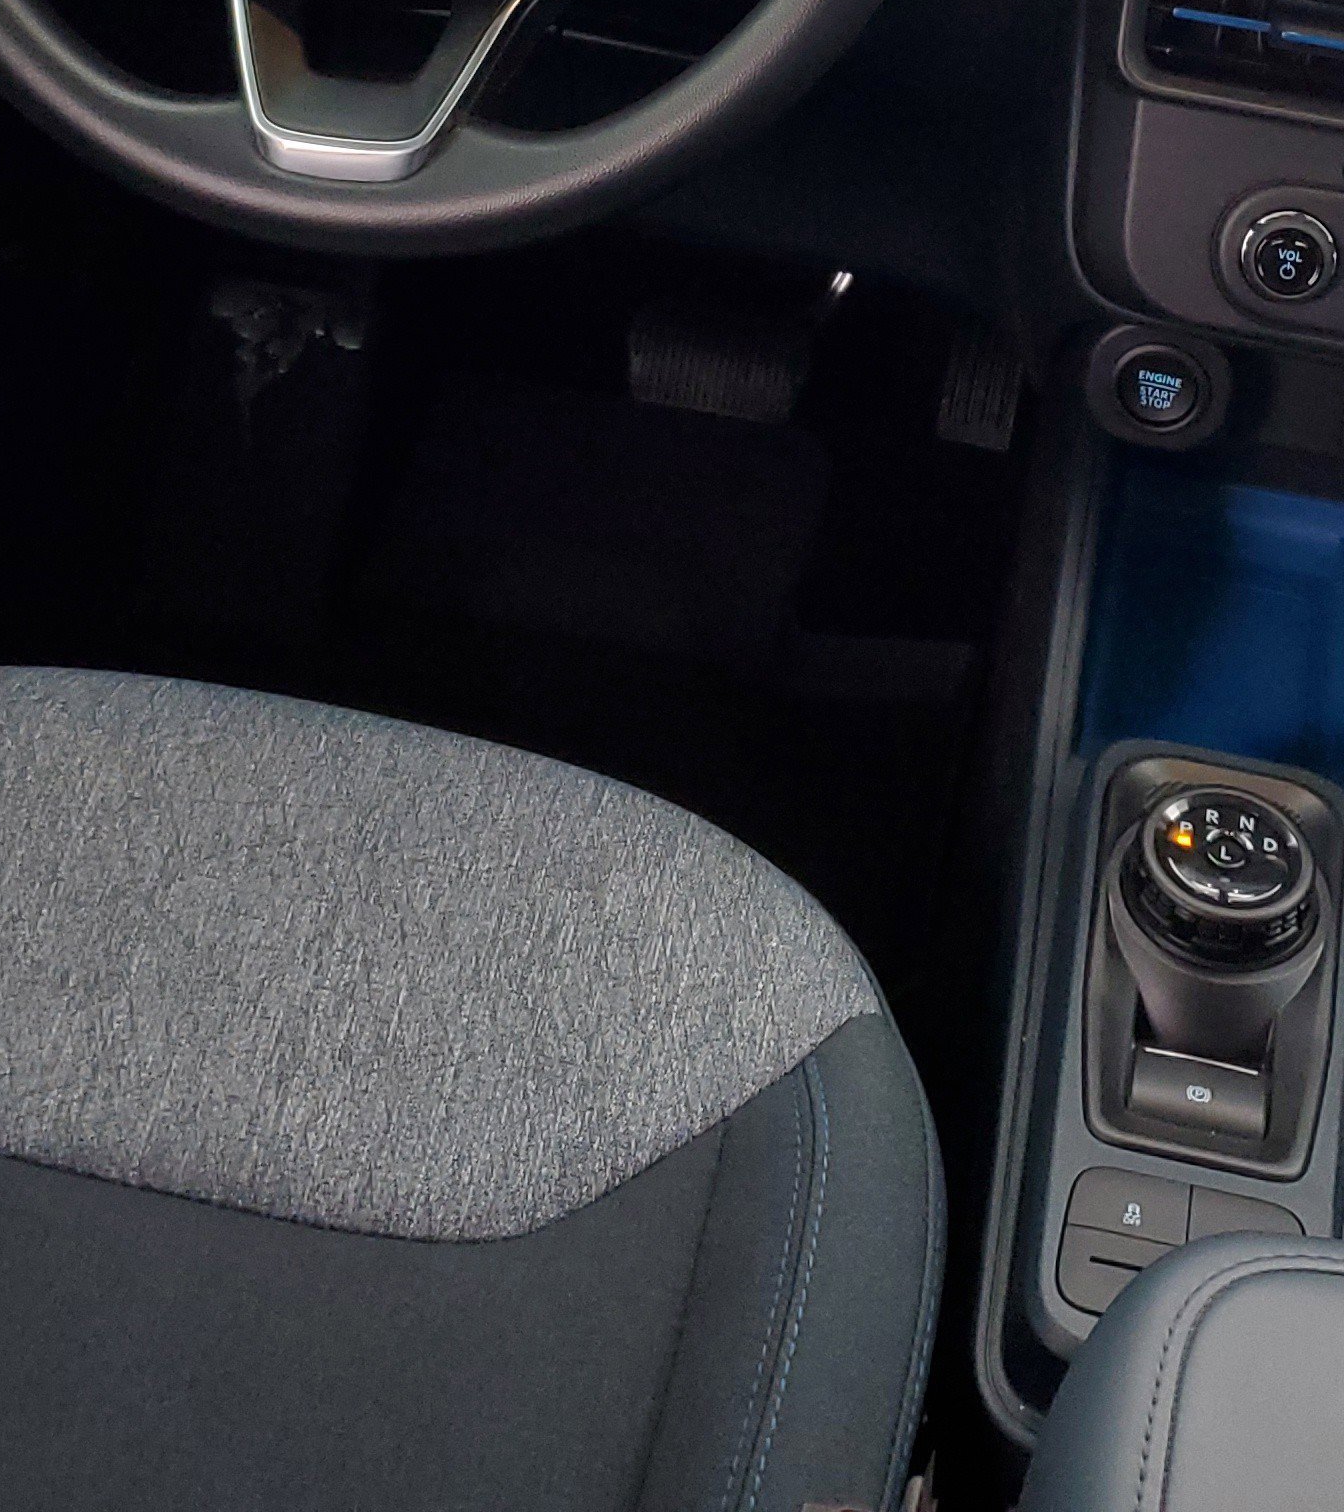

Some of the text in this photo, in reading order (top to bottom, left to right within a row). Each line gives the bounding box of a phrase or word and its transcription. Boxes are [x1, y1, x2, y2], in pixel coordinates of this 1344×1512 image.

[1278, 248, 1303, 263] VOL
[1138, 369, 1183, 389] ENGINE
[1139, 385, 1177, 402] START
[1140, 395, 1172, 410] STOP
[1179, 808, 1279, 853] P R N D
[1220, 845, 1233, 861] L
